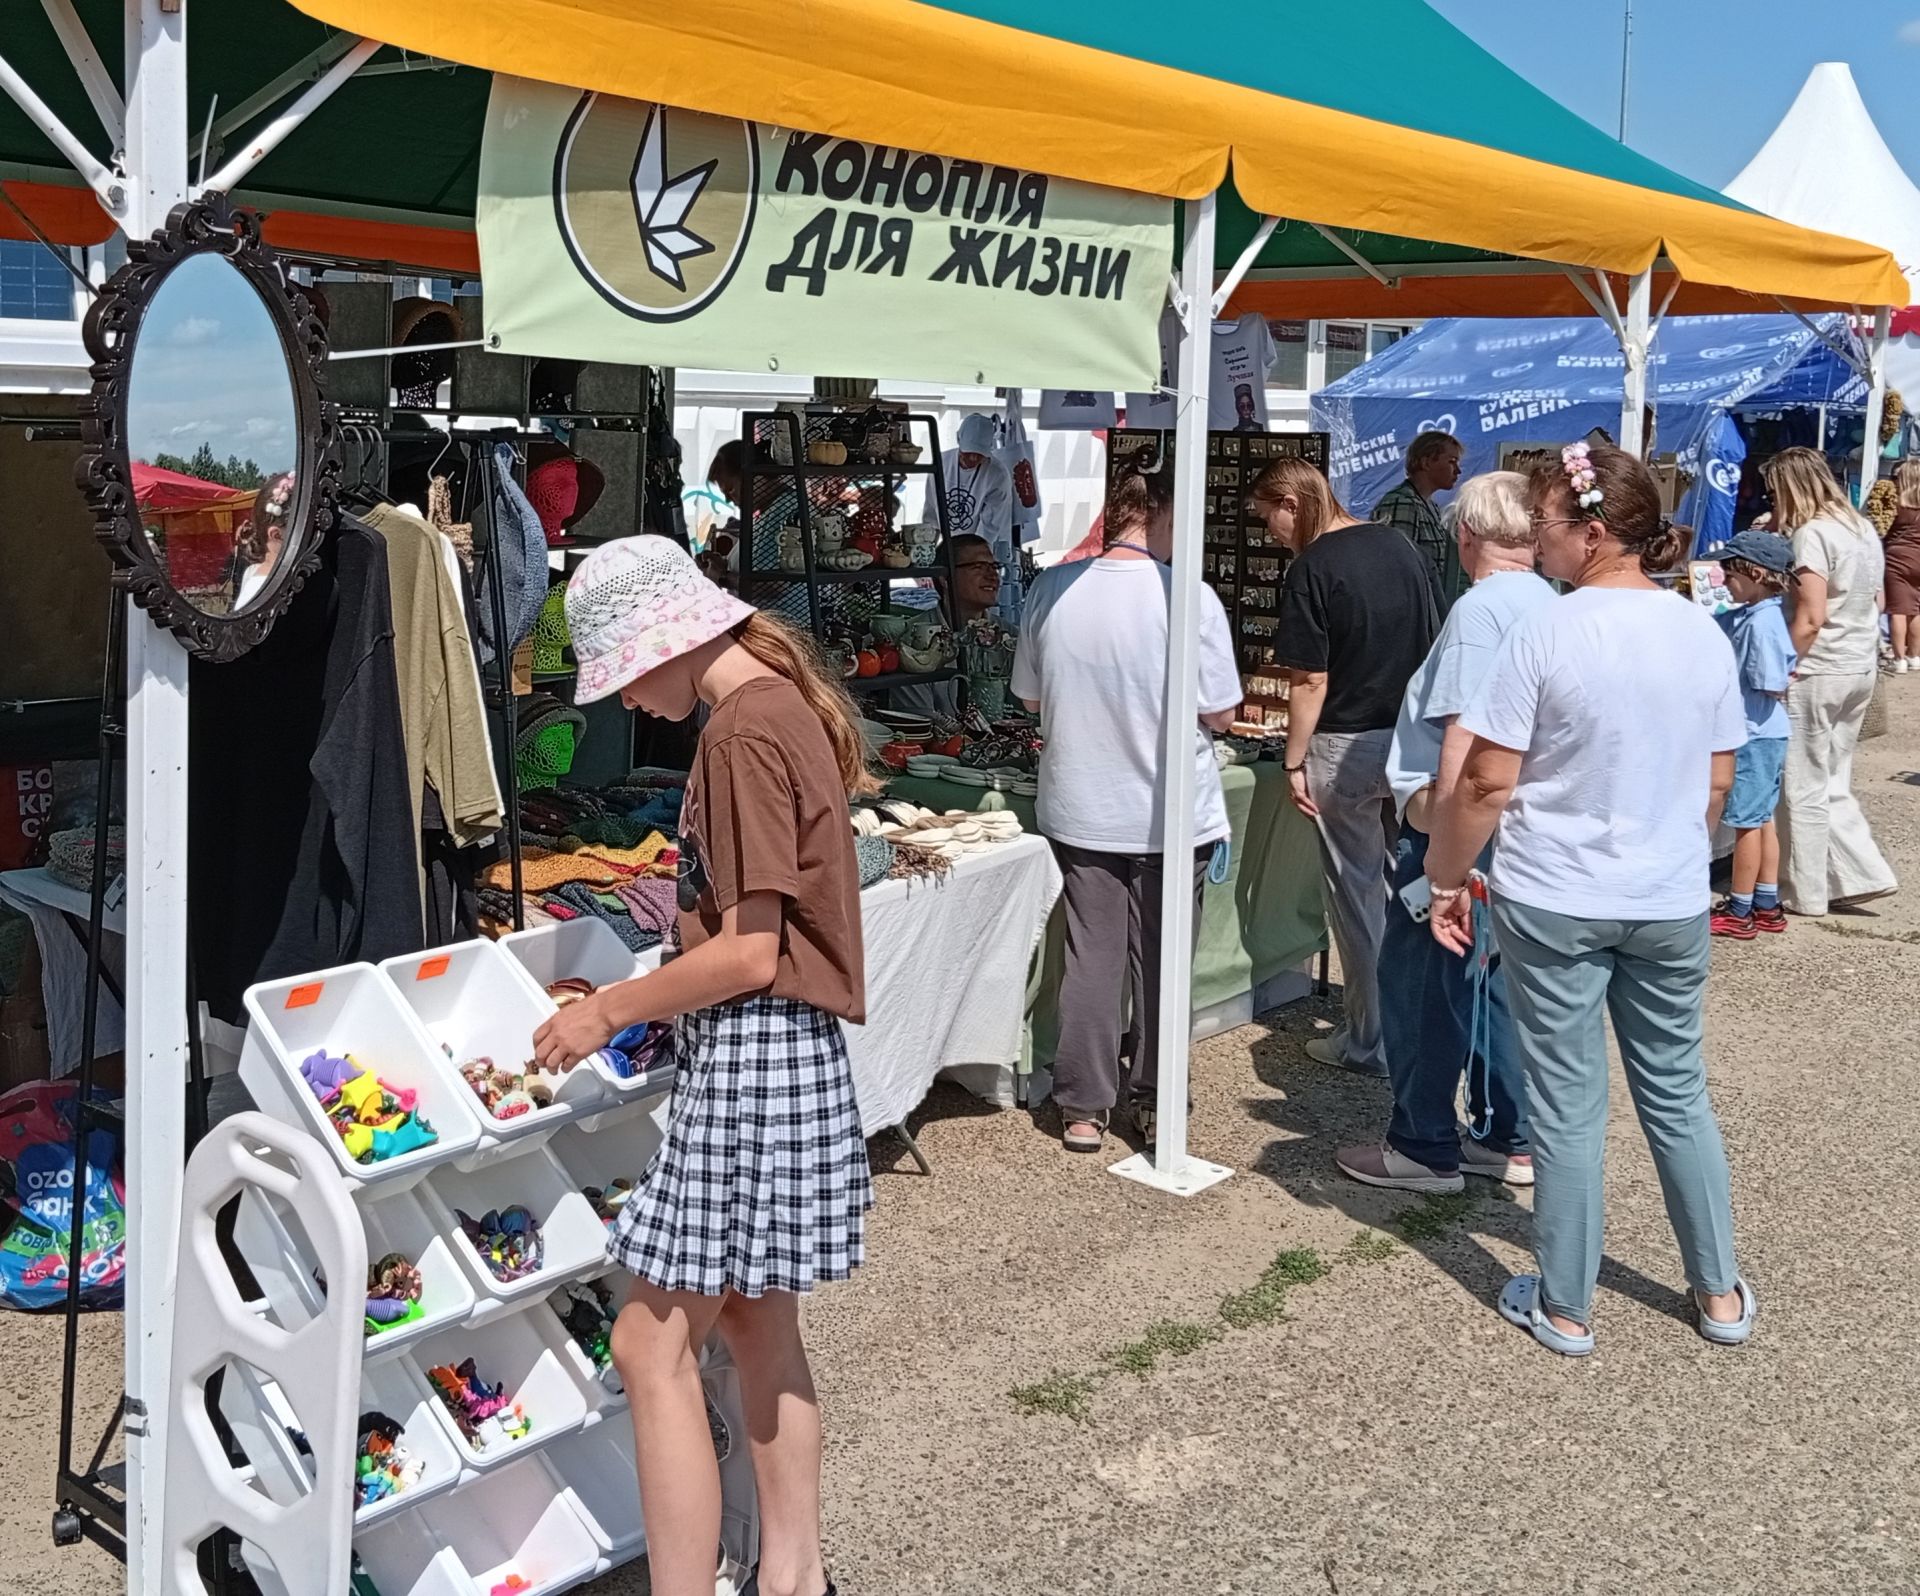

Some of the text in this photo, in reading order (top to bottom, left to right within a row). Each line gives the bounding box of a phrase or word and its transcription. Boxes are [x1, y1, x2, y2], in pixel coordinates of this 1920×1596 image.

[775, 132, 1049, 229] КОНОПЛЯ
[765, 207, 1132, 301] ДЛЯ ЖИЗНИ
[1480, 399, 1587, 433] ВАЛЕНК
[1329, 445, 1401, 479] АЛЕНКИ
[1330, 432, 1396, 461] МОРСКИЕ
[17, 768, 53, 791] БО
[18, 793, 53, 816] КР
